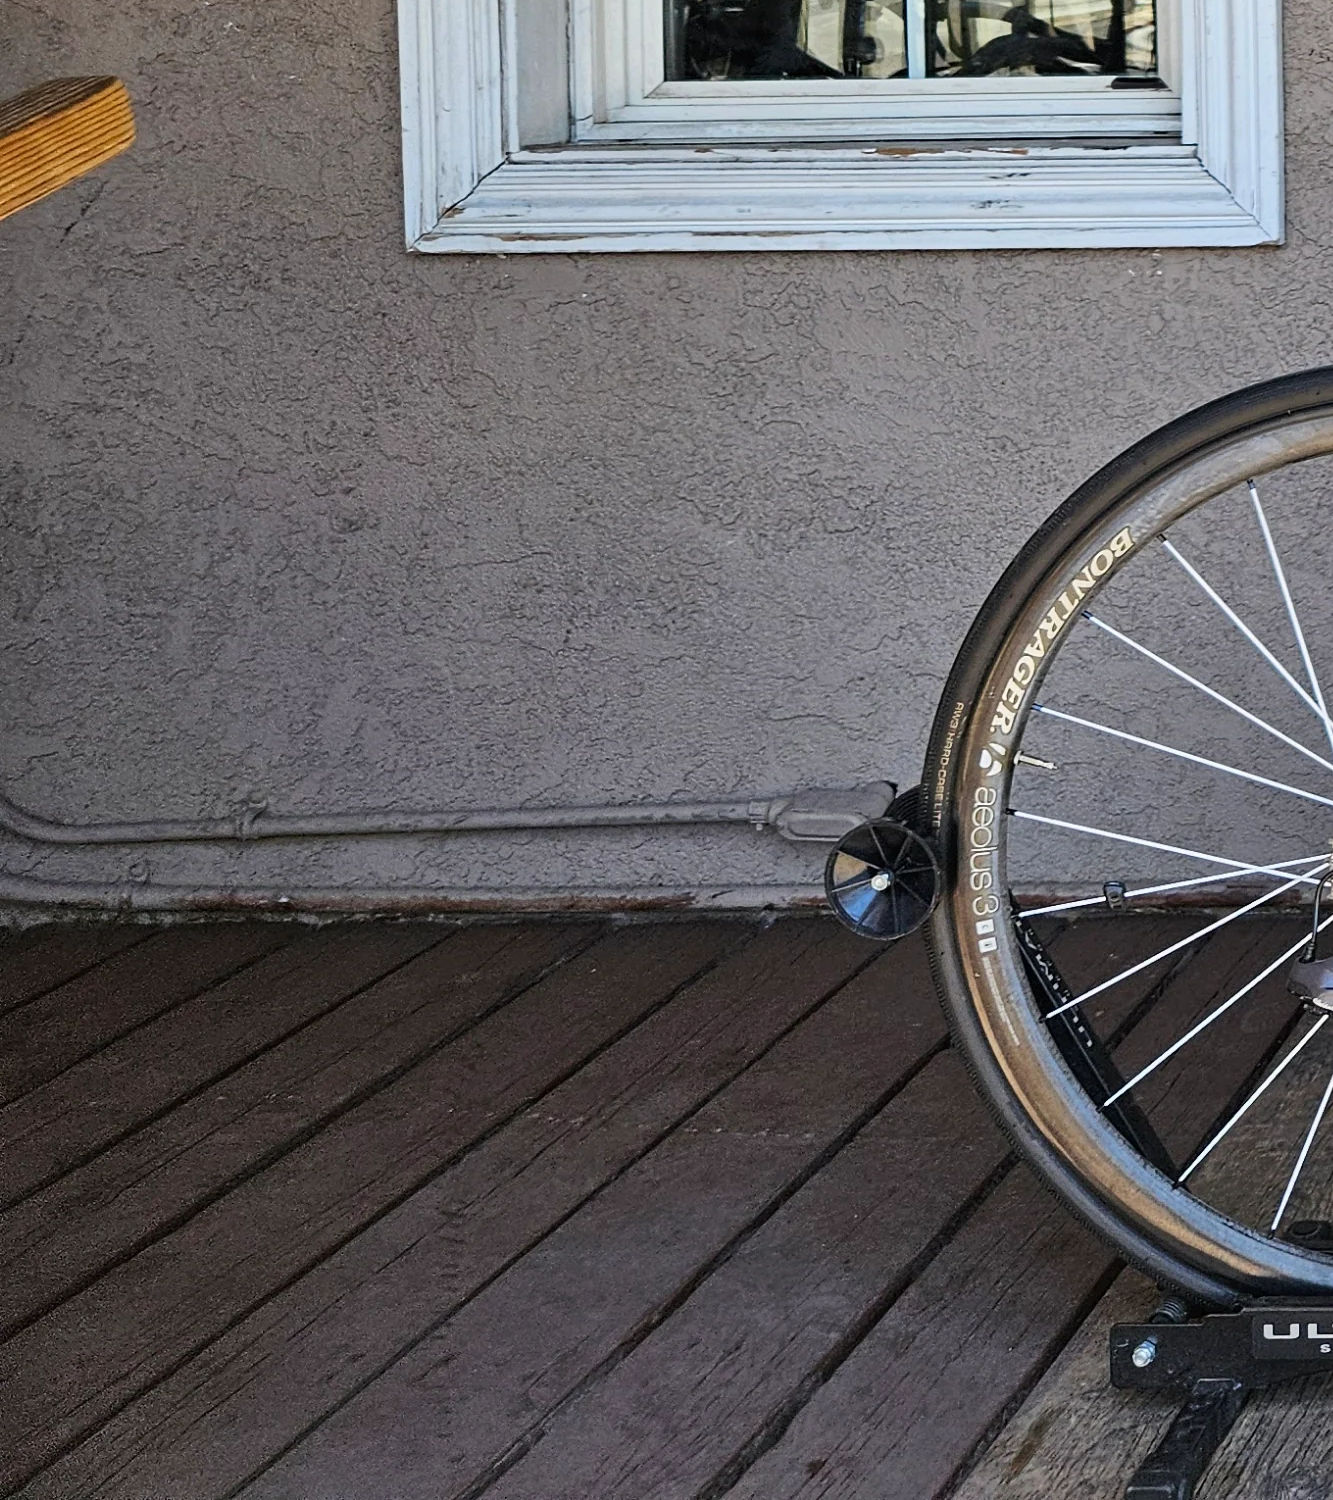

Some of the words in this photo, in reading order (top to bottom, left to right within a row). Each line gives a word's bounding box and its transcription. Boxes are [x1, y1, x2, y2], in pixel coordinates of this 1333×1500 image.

[934, 732, 956, 803] HARD-CASE
[931, 804, 943, 828] LITE
[969, 786, 998, 891] aeolus
[972, 894, 1000, 917] 3
